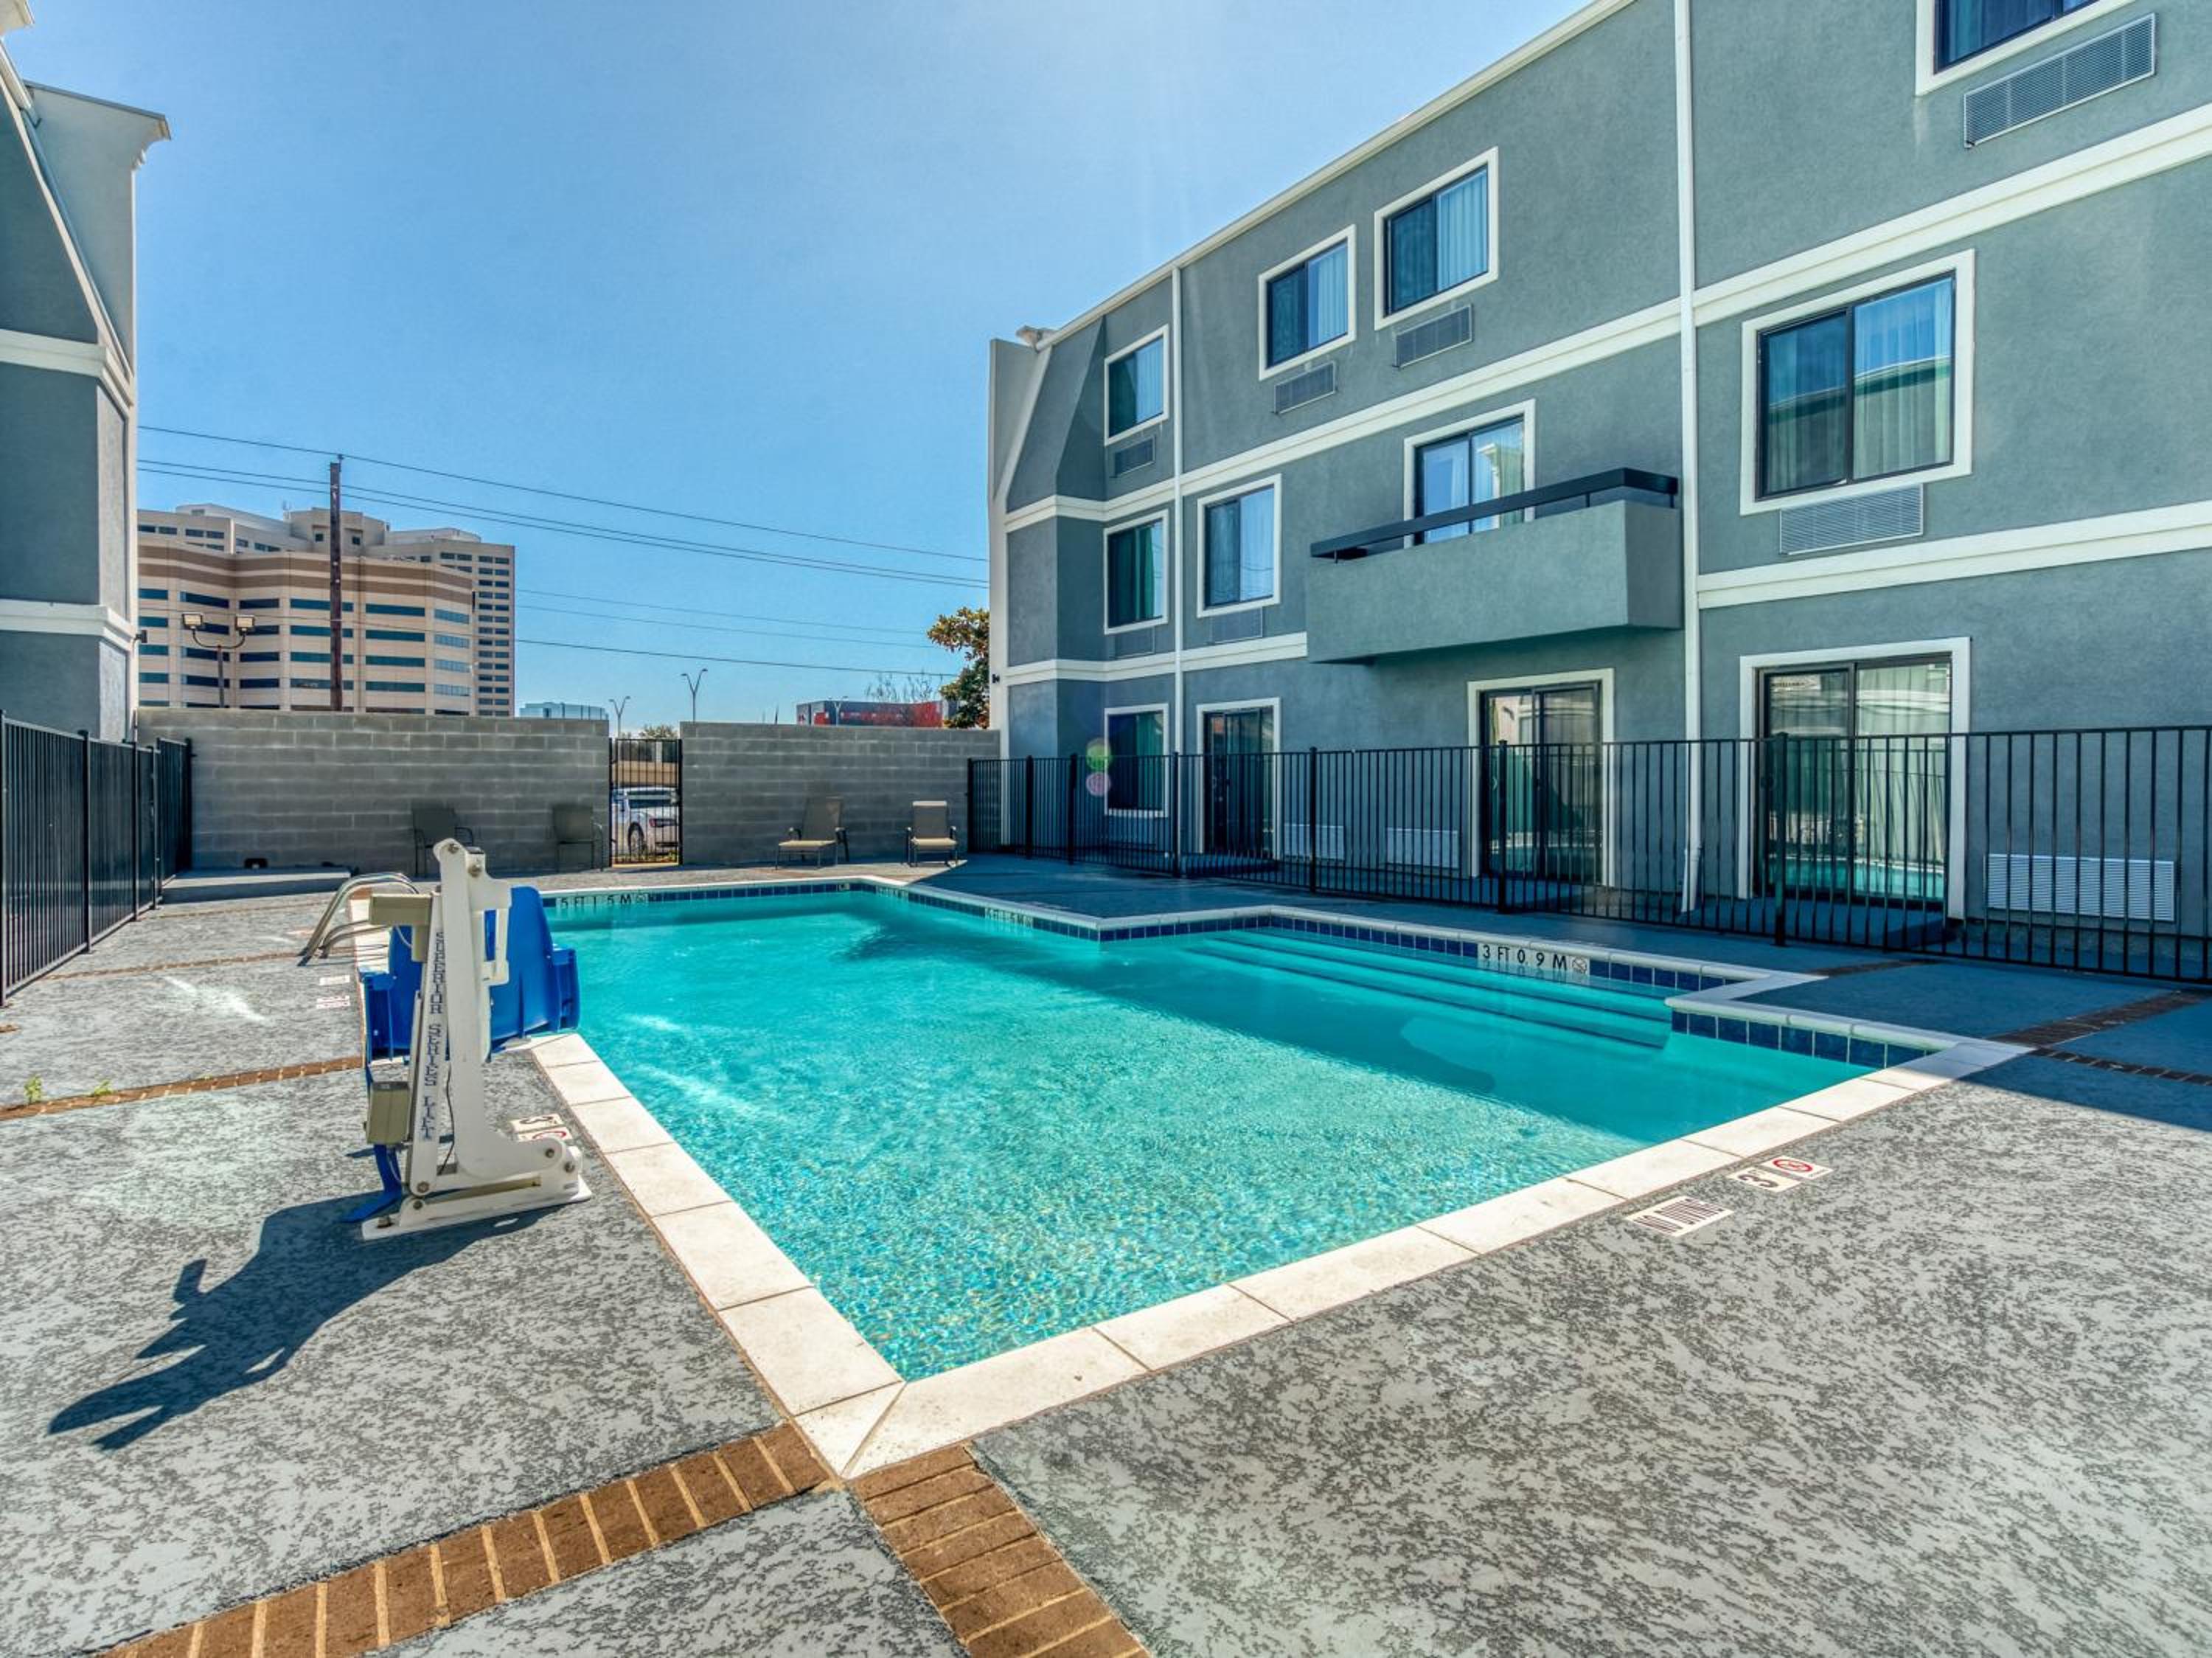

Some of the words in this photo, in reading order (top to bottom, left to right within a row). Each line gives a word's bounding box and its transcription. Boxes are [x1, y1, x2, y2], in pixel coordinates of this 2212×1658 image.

[620, 893, 632, 904] M
[430, 932, 445, 1013] SUPERIOR
[1483, 945, 1490, 959] 3
[1498, 946, 1510, 961] FT
[1552, 954, 1567, 971] M
[425, 1024, 441, 1086] SERIES
[421, 1096, 435, 1138] LIFT
